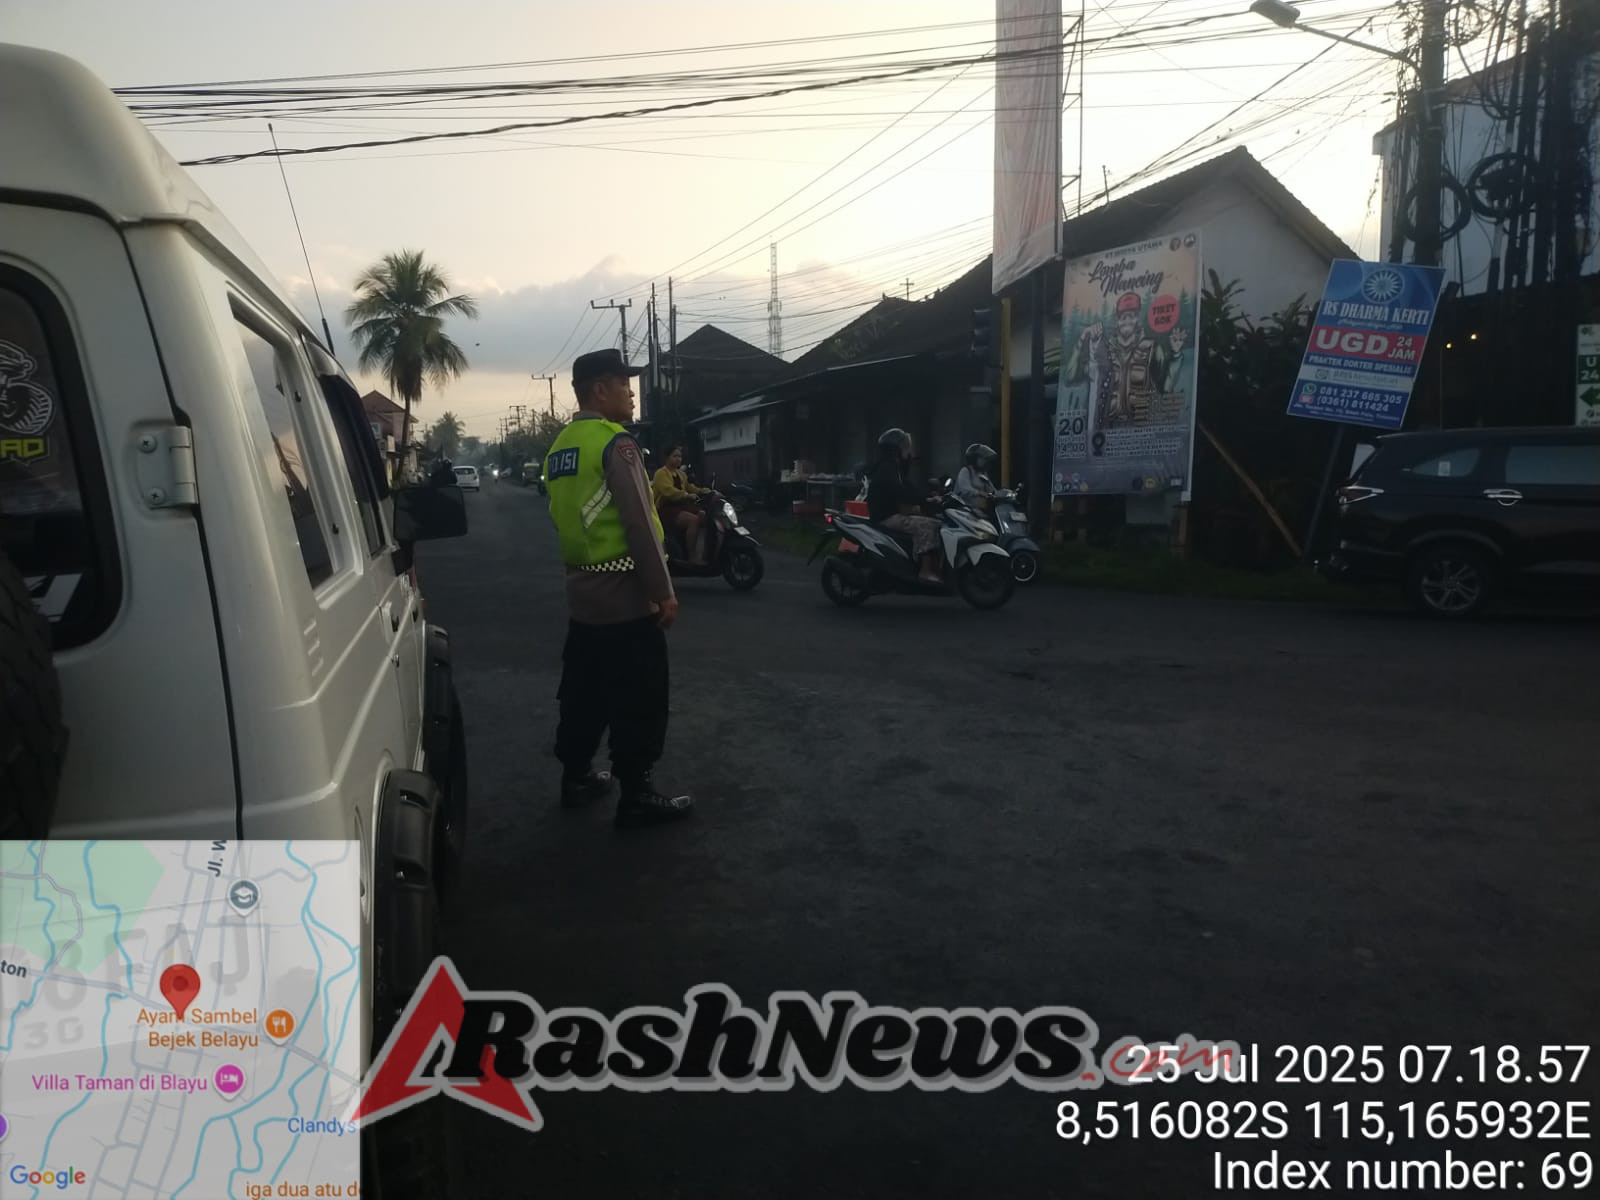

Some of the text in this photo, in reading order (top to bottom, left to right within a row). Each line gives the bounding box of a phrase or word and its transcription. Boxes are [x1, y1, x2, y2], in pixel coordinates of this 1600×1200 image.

[1088, 258, 1136, 284] Lomba
[1099, 269, 1164, 298] Mancing
[1324, 301, 1431, 325] RS DHARMA KERTI
[1316, 328, 1389, 355] UGD
[1397, 336, 1413, 347] 24
[1388, 348, 1416, 361] JAM
[1343, 358, 1374, 371] DOKTER
[1316, 395, 1350, 408] (0361)
[1340, 387, 1360, 399] 237
[1383, 392, 1403, 405] 305
[1058, 417, 1084, 436] 20
